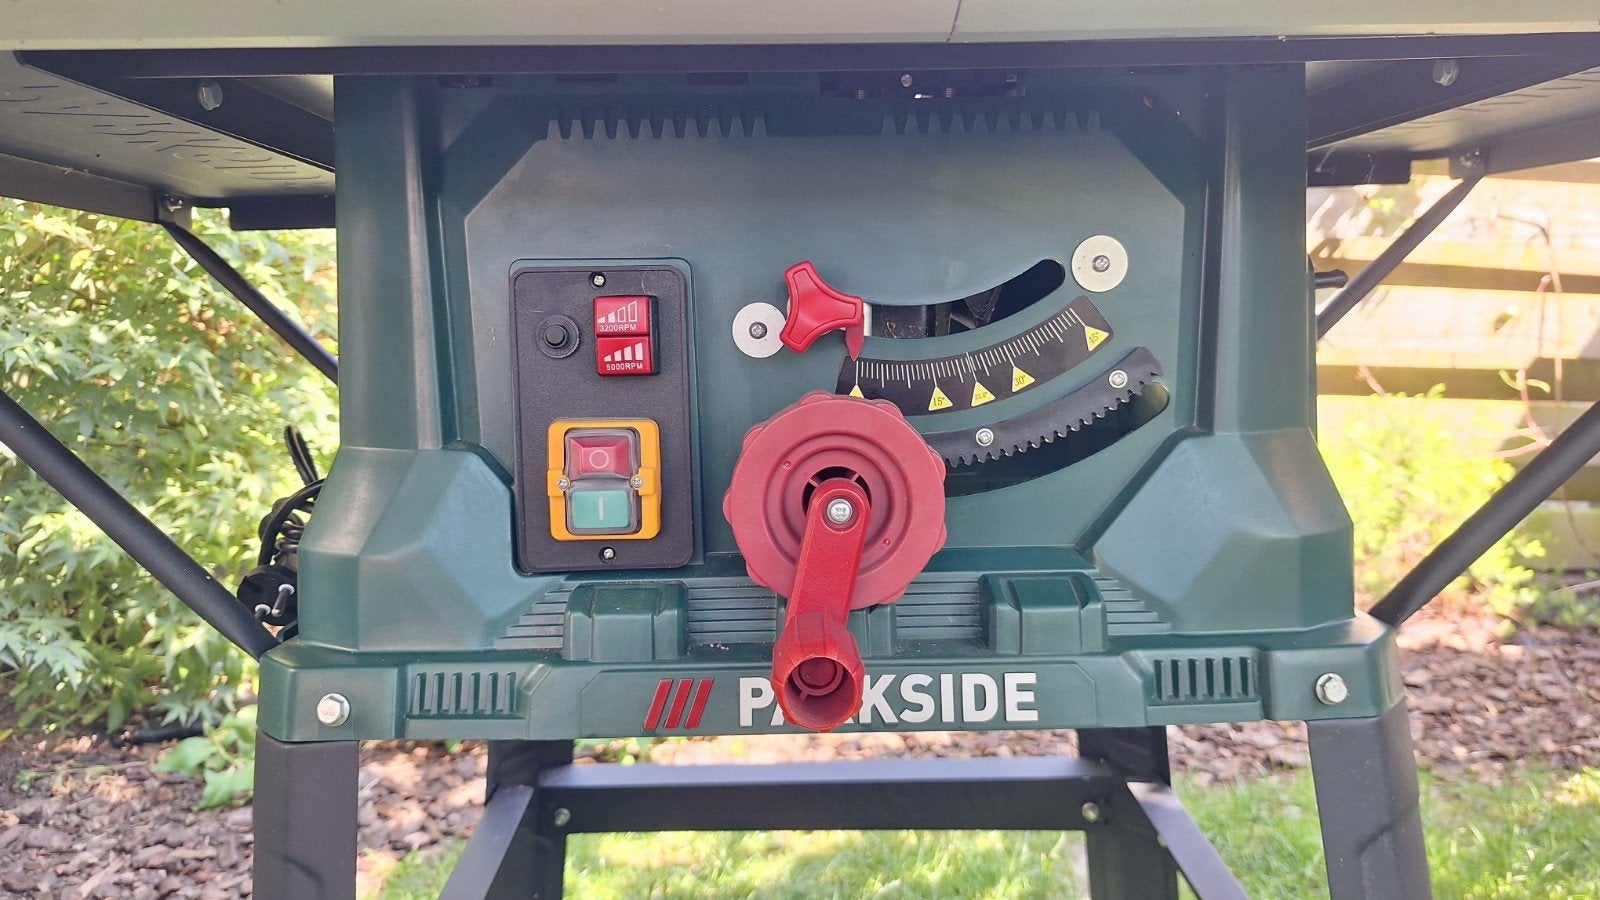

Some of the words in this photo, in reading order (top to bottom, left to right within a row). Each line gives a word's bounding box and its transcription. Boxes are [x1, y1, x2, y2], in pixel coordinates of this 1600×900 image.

[599, 323, 637, 332] 3200RPM
[606, 362, 643, 371] 5000RPM
[933, 397, 945, 406] 15°
[1013, 375, 1026, 387] 30°
[739, 672, 1039, 726] PKSIDE
